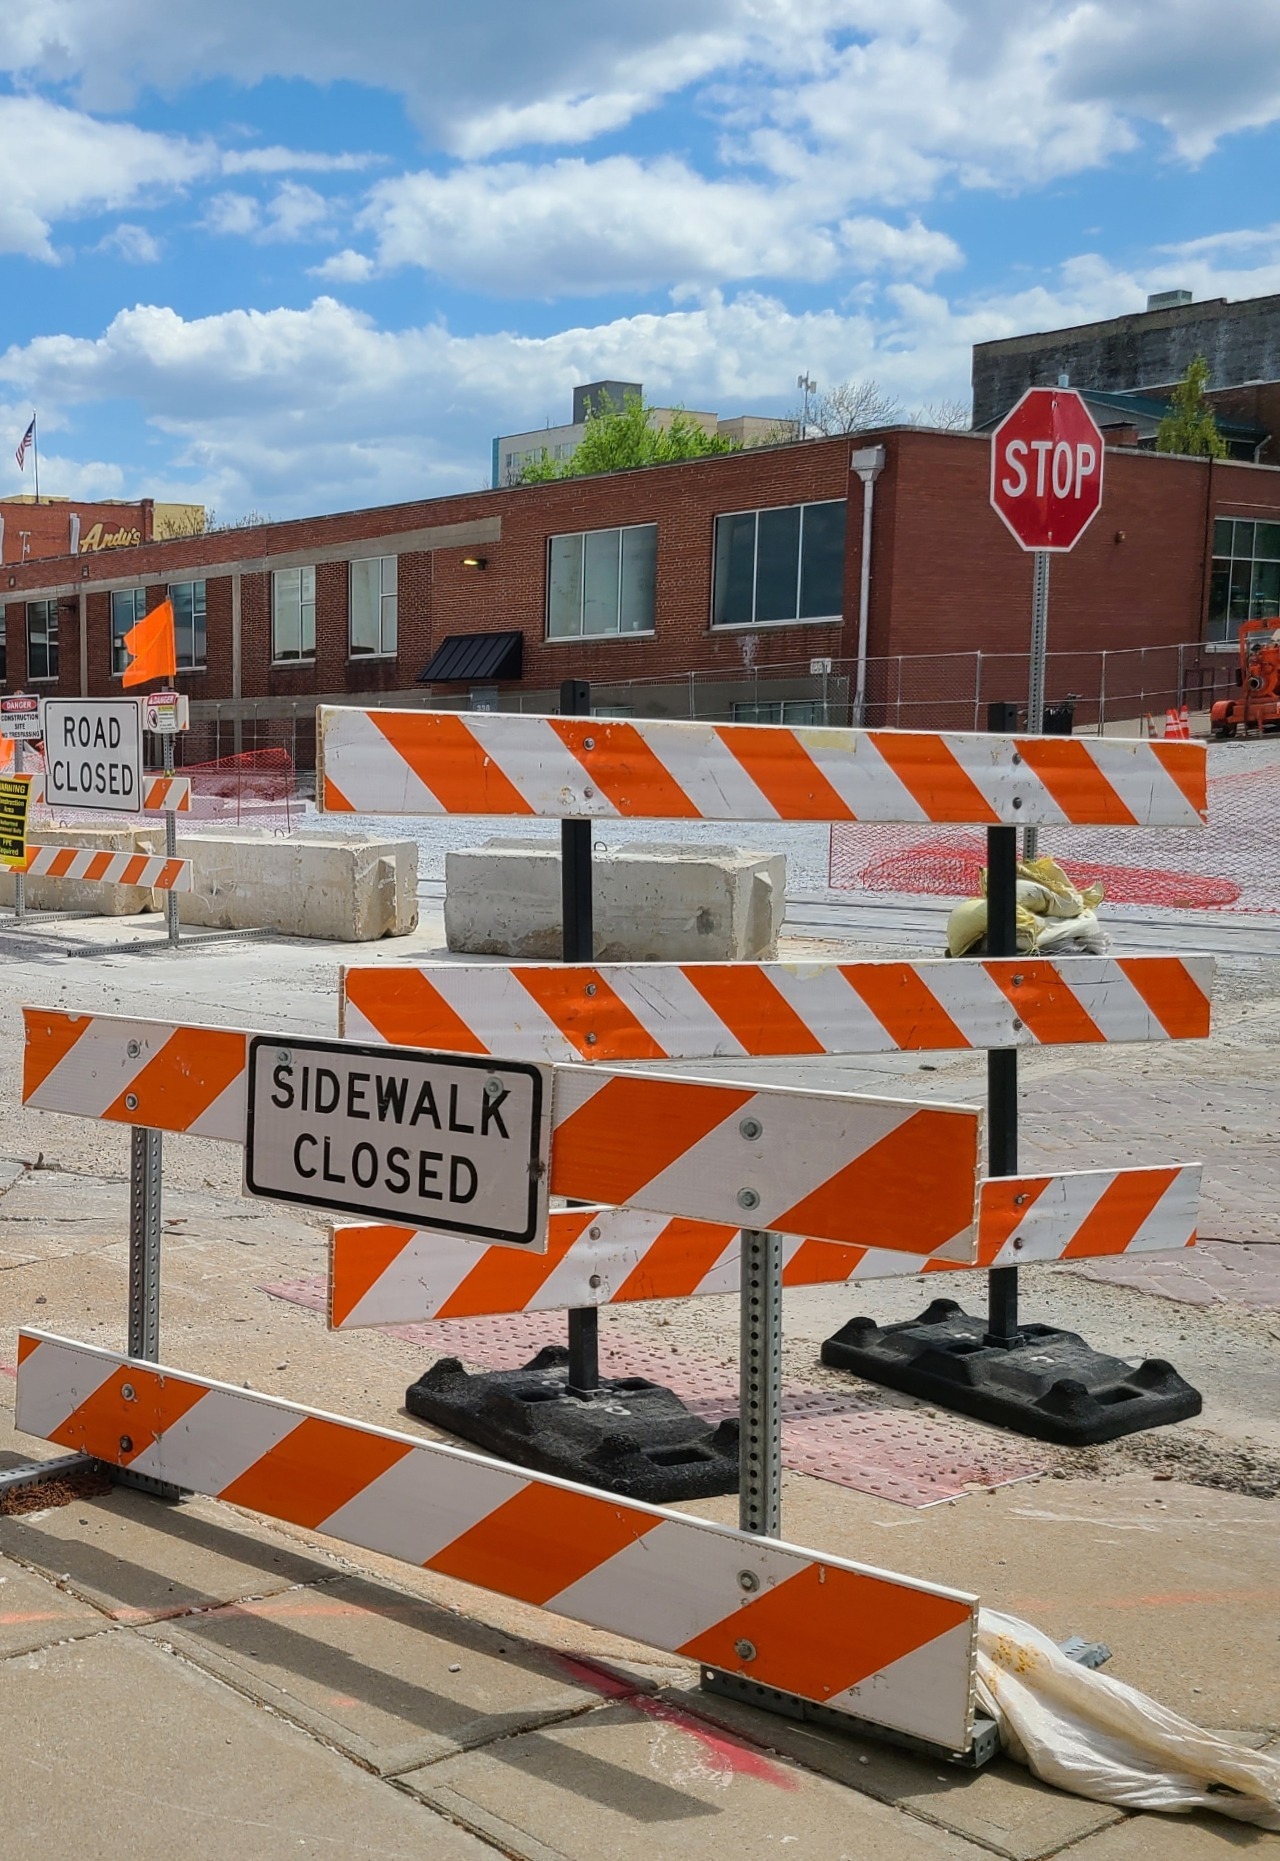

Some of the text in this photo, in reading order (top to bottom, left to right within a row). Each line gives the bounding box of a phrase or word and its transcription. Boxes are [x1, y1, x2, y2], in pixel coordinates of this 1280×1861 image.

[1002, 440, 1096, 499] STOP
[80, 522, 141, 553] Andy's
[1, 713, 38, 721] CONSTRUCTION
[6, 701, 32, 709] DANGER
[64, 716, 121, 749] ROAD
[53, 760, 133, 796] CLOSED
[3, 805, 14, 813] Area
[2, 838, 12, 846] PPE
[271, 1065, 511, 1139] SIDEWALK
[293, 1133, 479, 1204] CLOSED
